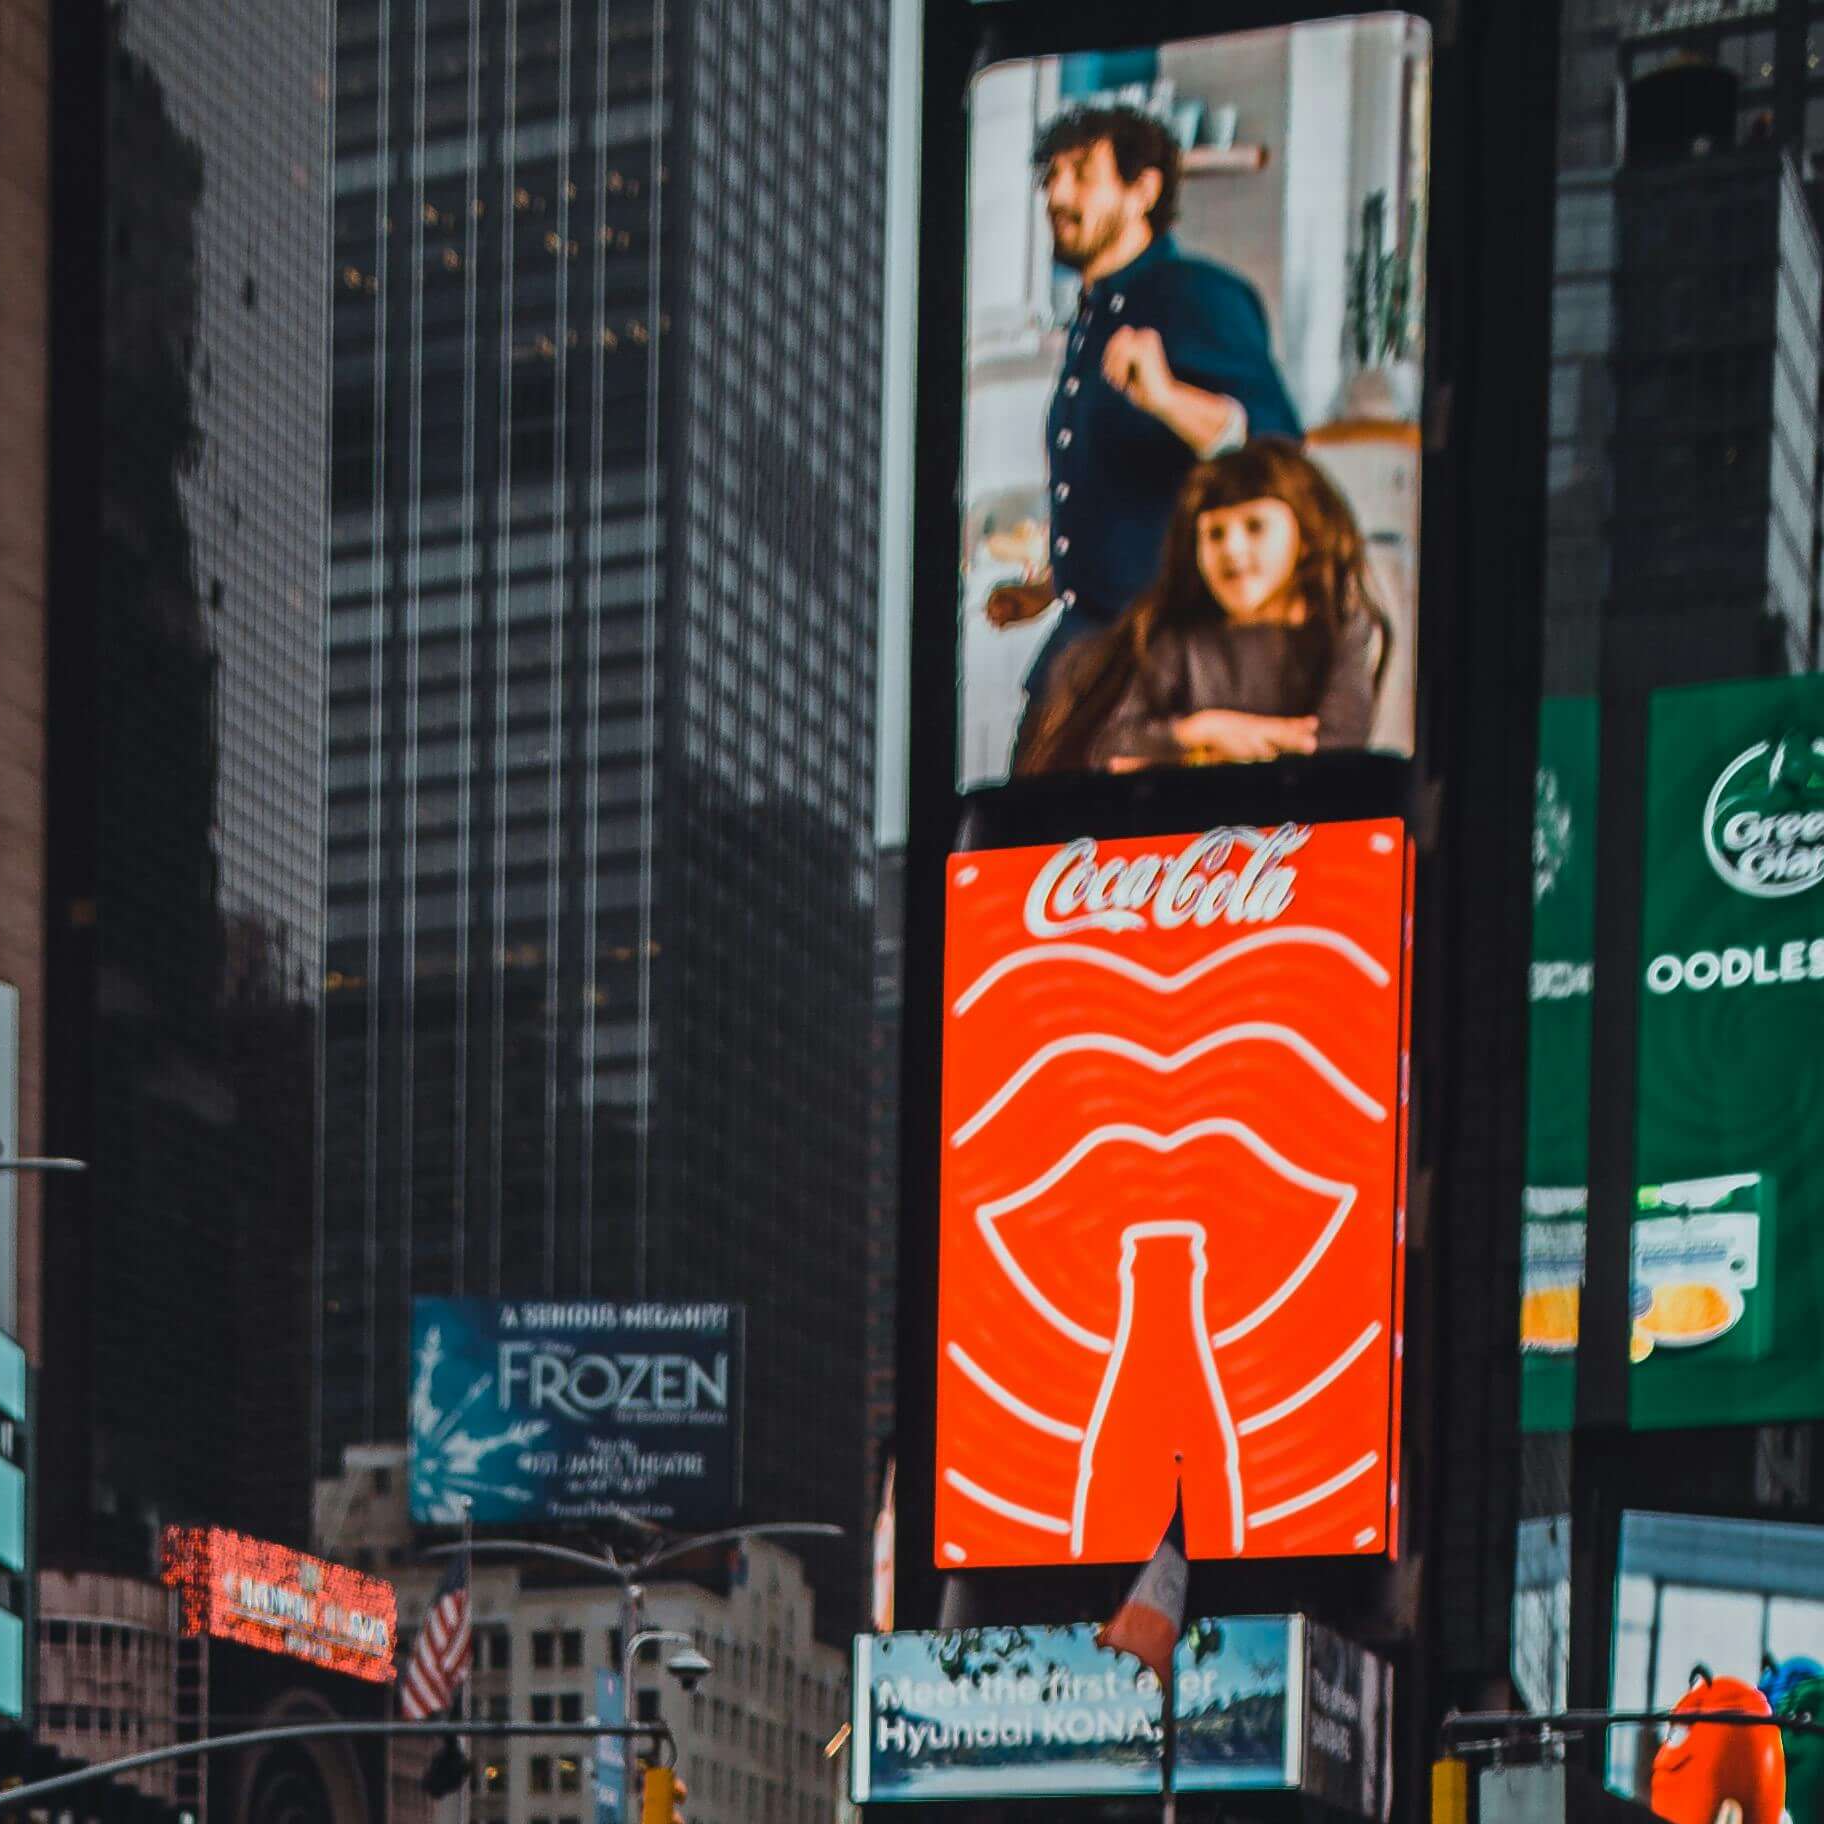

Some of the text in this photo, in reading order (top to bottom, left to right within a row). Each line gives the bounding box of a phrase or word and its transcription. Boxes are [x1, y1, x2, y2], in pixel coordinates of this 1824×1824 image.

[497, 1340, 728, 1422] FROZEN
[878, 1678, 973, 1709] Meet
[877, 1712, 1032, 1756] Hyundai
